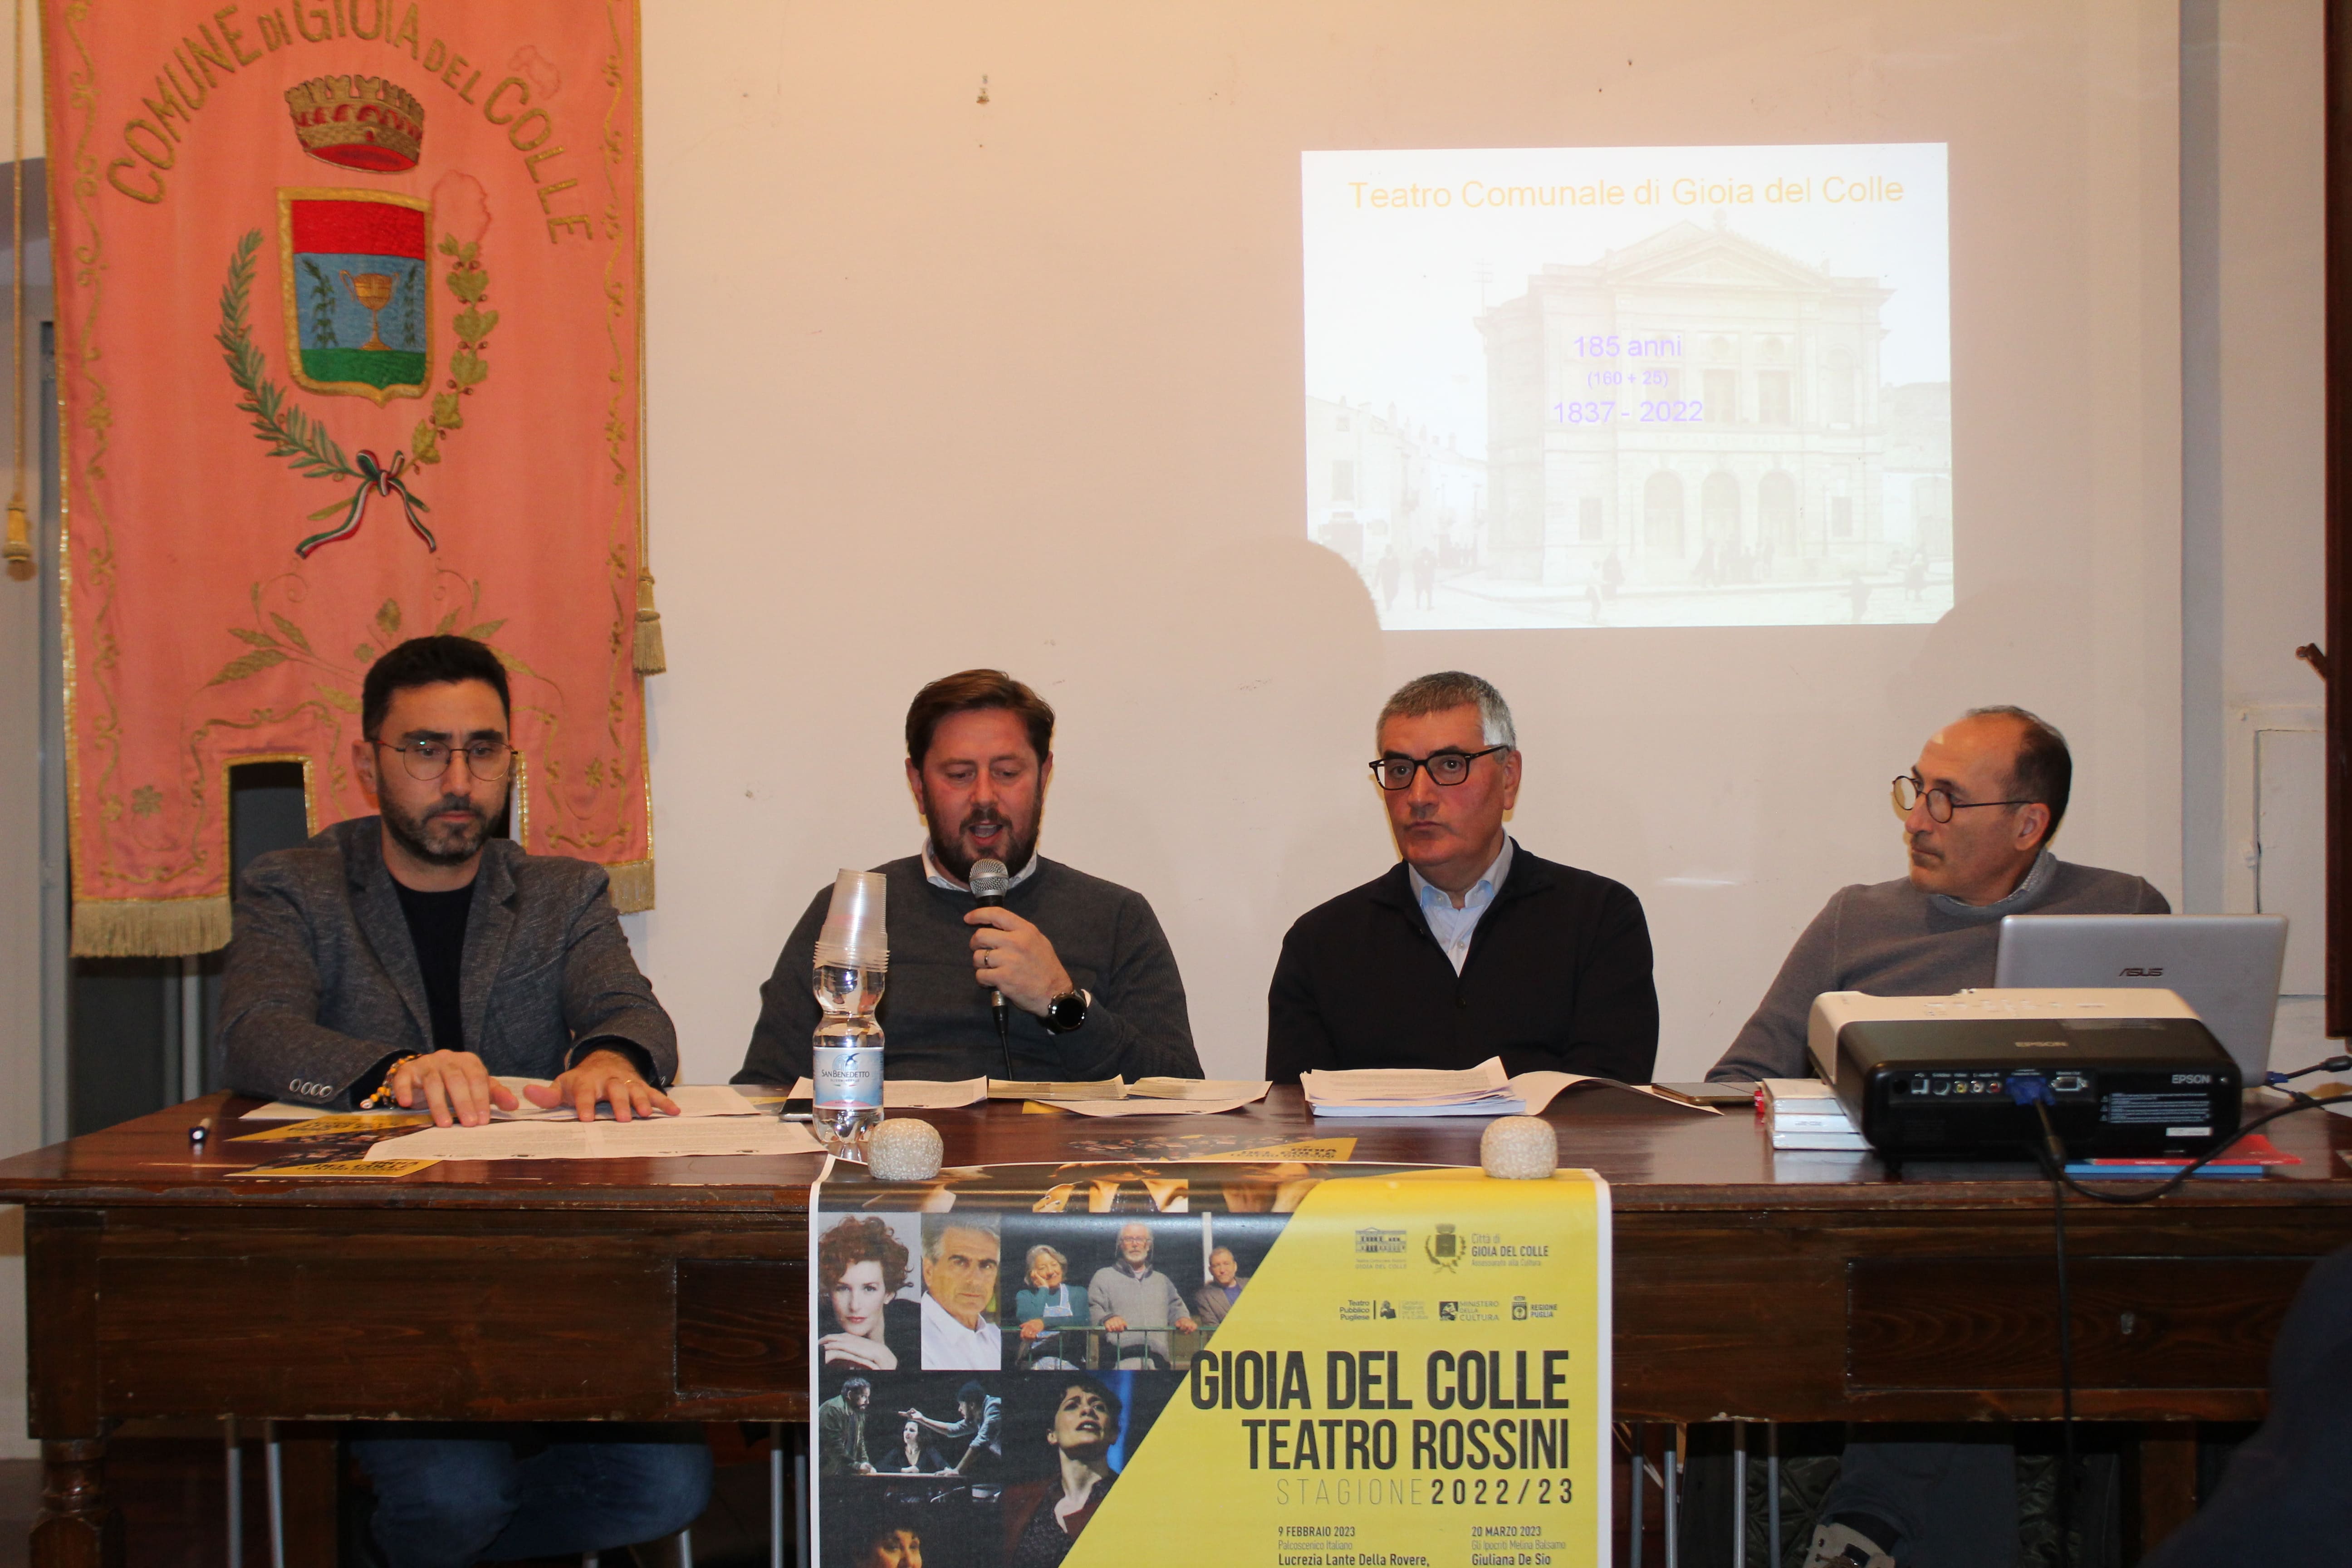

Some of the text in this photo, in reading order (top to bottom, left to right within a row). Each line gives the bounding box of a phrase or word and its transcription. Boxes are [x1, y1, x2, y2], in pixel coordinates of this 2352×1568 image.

[107, 0, 593, 244] COMUNE DI GIOIA DEL COLLE
[1349, 176, 1904, 208] Teatro Comunale di Gioia del Colle
[1573, 335, 1682, 357] 185 anni
[1588, 370, 1622, 390] (160
[1642, 370, 1668, 388] 25)
[1553, 401, 1616, 423] 1837
[1639, 400, 1703, 422] 2022
[2119, 968, 2163, 977] ASUS
[2172, 1074, 2211, 1084] EPSON
[1471, 1233, 1500, 1244] Città di
[1471, 1245, 1549, 1256] GIOIA DEL COLLE
[1190, 1350, 1569, 1410] GIOIA DEL COLLE
[1242, 1418, 1568, 1470] TEATRO ROSSINI
[1277, 1478, 1573, 1505] STAGIONE 2022/23
[1278, 1526, 1355, 1537] 9 FEBBRAIO 2023
[1471, 1526, 1542, 1536] 20 MARZO 2023
[1278, 1540, 1352, 1551] Palcoscenico Italiano
[1471, 1539, 1481, 1549] Gli
[1509, 1539, 1533, 1549] Melina
[1534, 1539, 1566, 1549] Balsamo
[1279, 1553, 1430, 1568] Lucrezia Lante Della Rovere,
[1472, 1553, 1550, 1566] Giuliana De Sio
